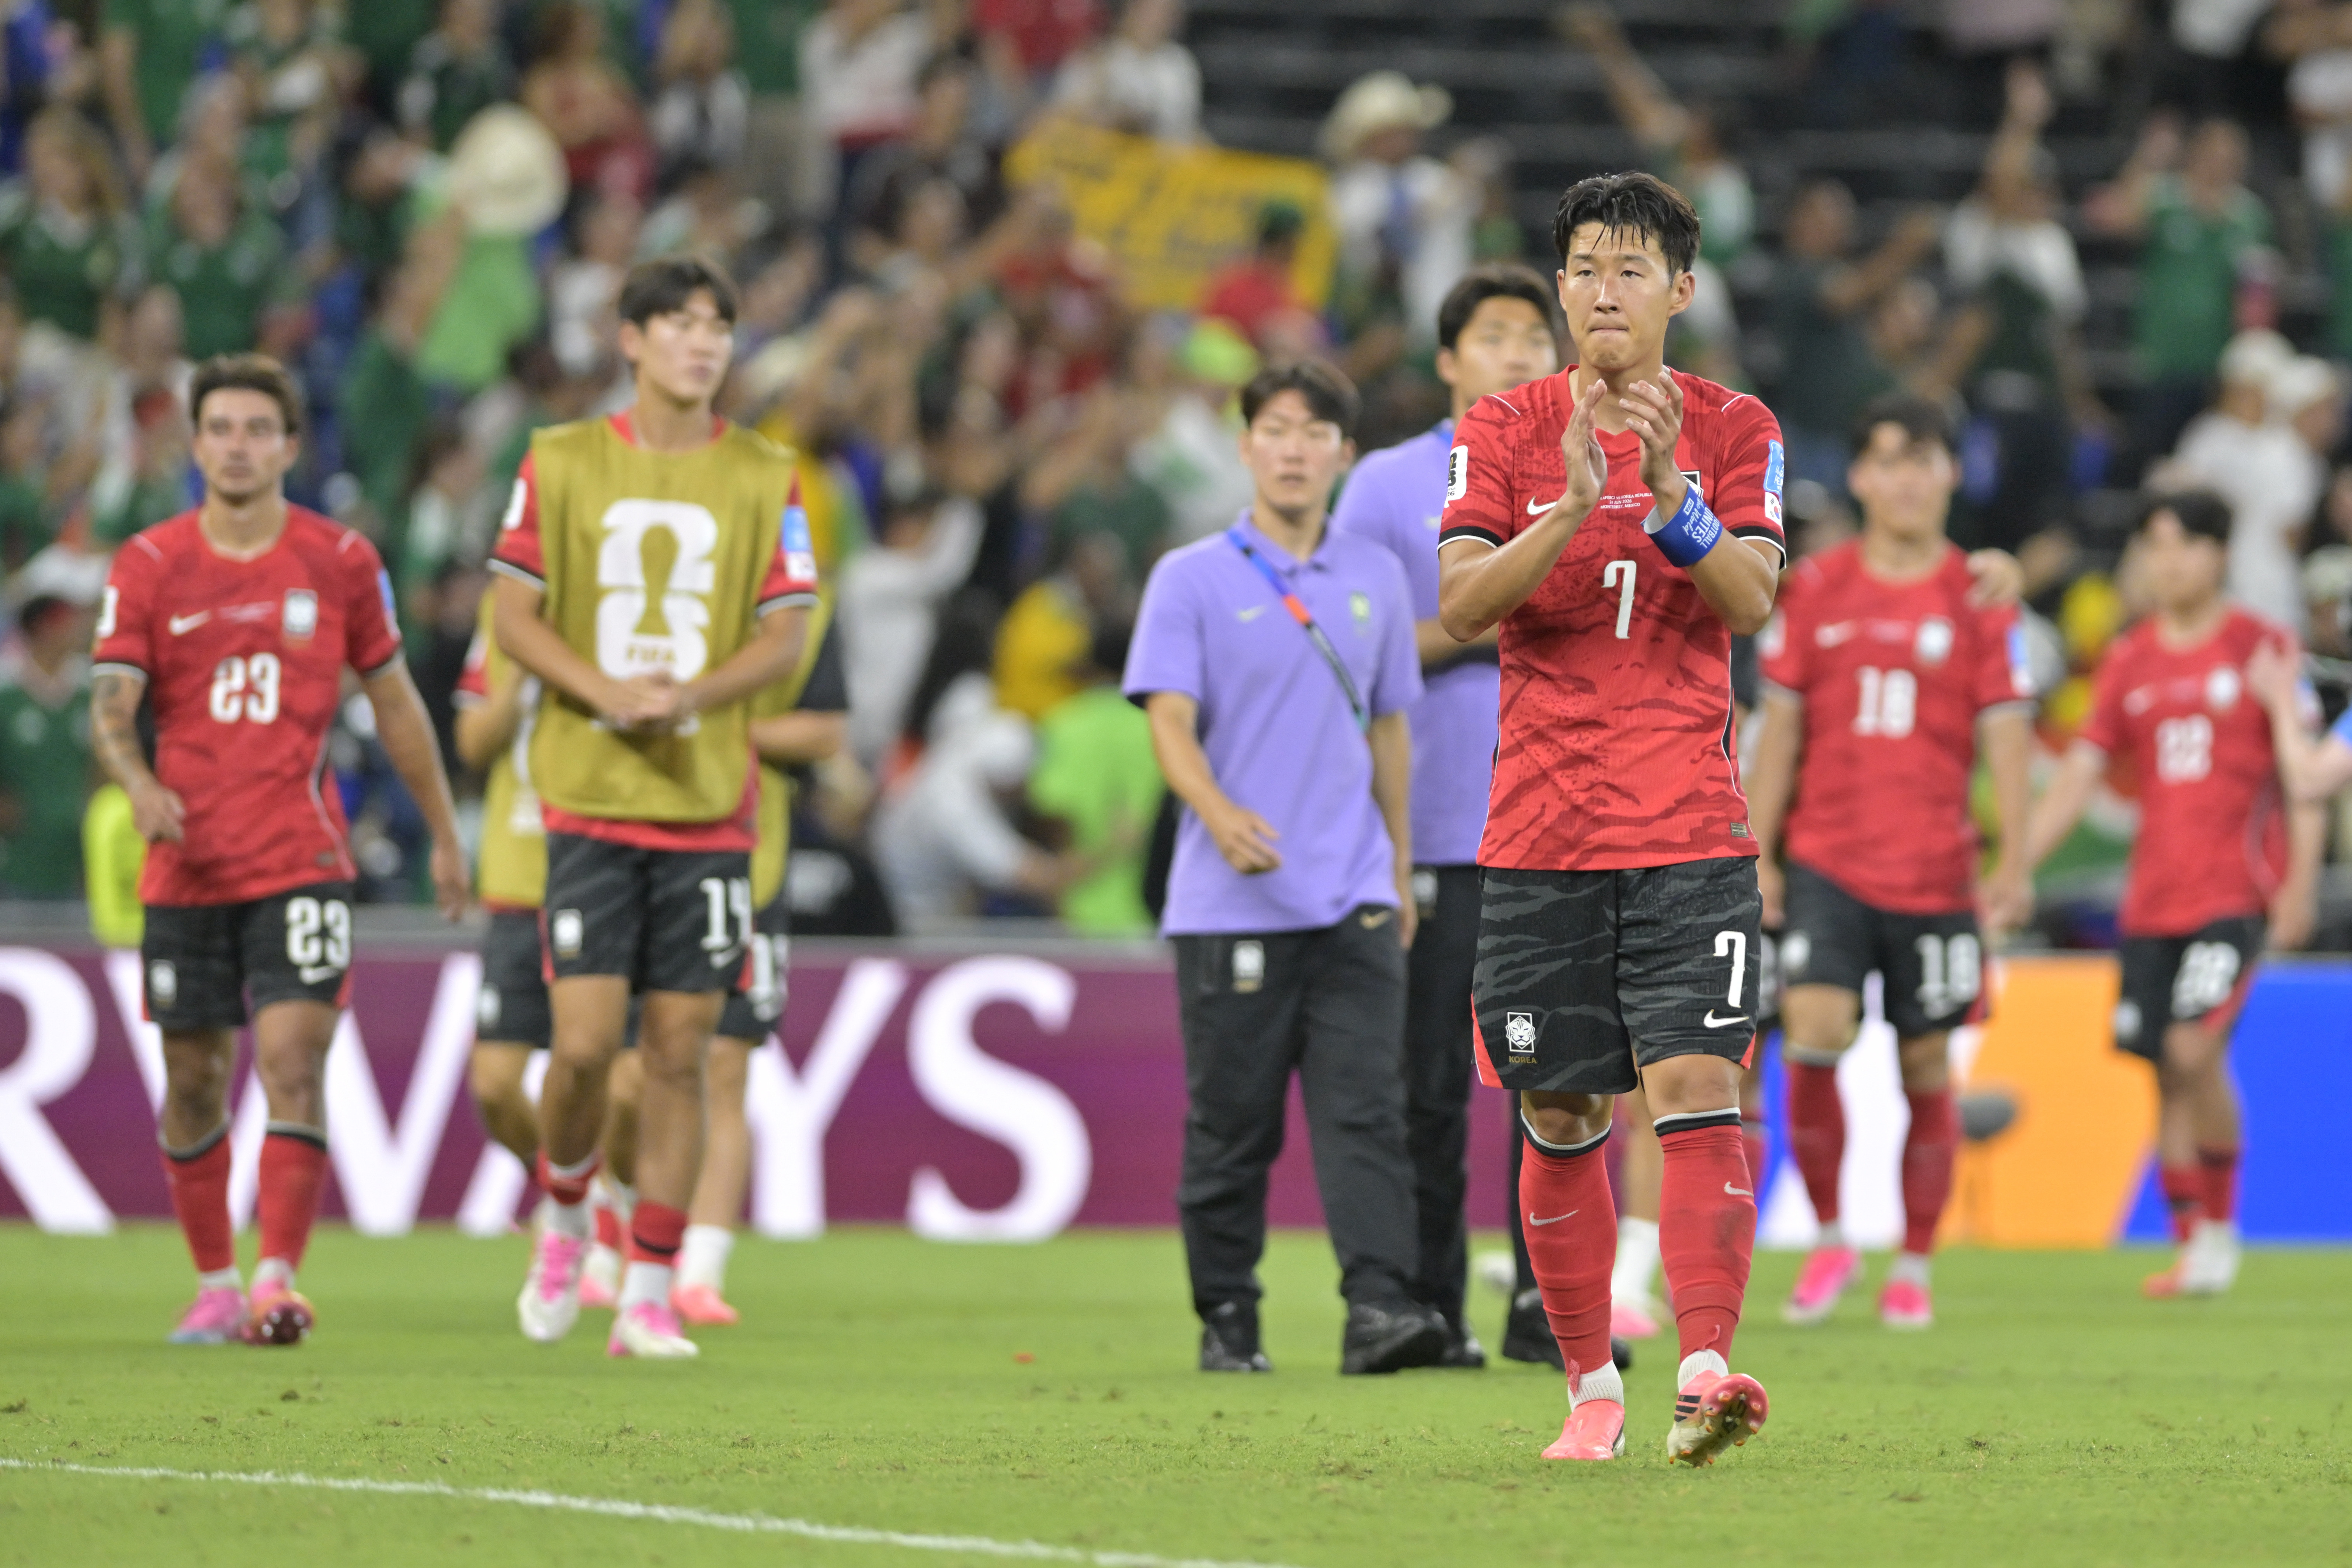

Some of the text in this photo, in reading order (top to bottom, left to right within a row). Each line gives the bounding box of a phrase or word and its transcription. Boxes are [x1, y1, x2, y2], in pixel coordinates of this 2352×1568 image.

[1682, 508, 1702, 535] World
[1684, 498, 1693, 514] FIFA
[1692, 507, 1713, 543] UNITES
[1700, 516, 1720, 548] FOOTBALL
[1601, 560, 1637, 639] 7
[211, 652, 280, 725] 23
[286, 896, 351, 970] 23
[1713, 931, 1746, 1008] 7
[1509, 1056, 1537, 1064] KOREA
[0, 948, 1093, 1242] RWYS
